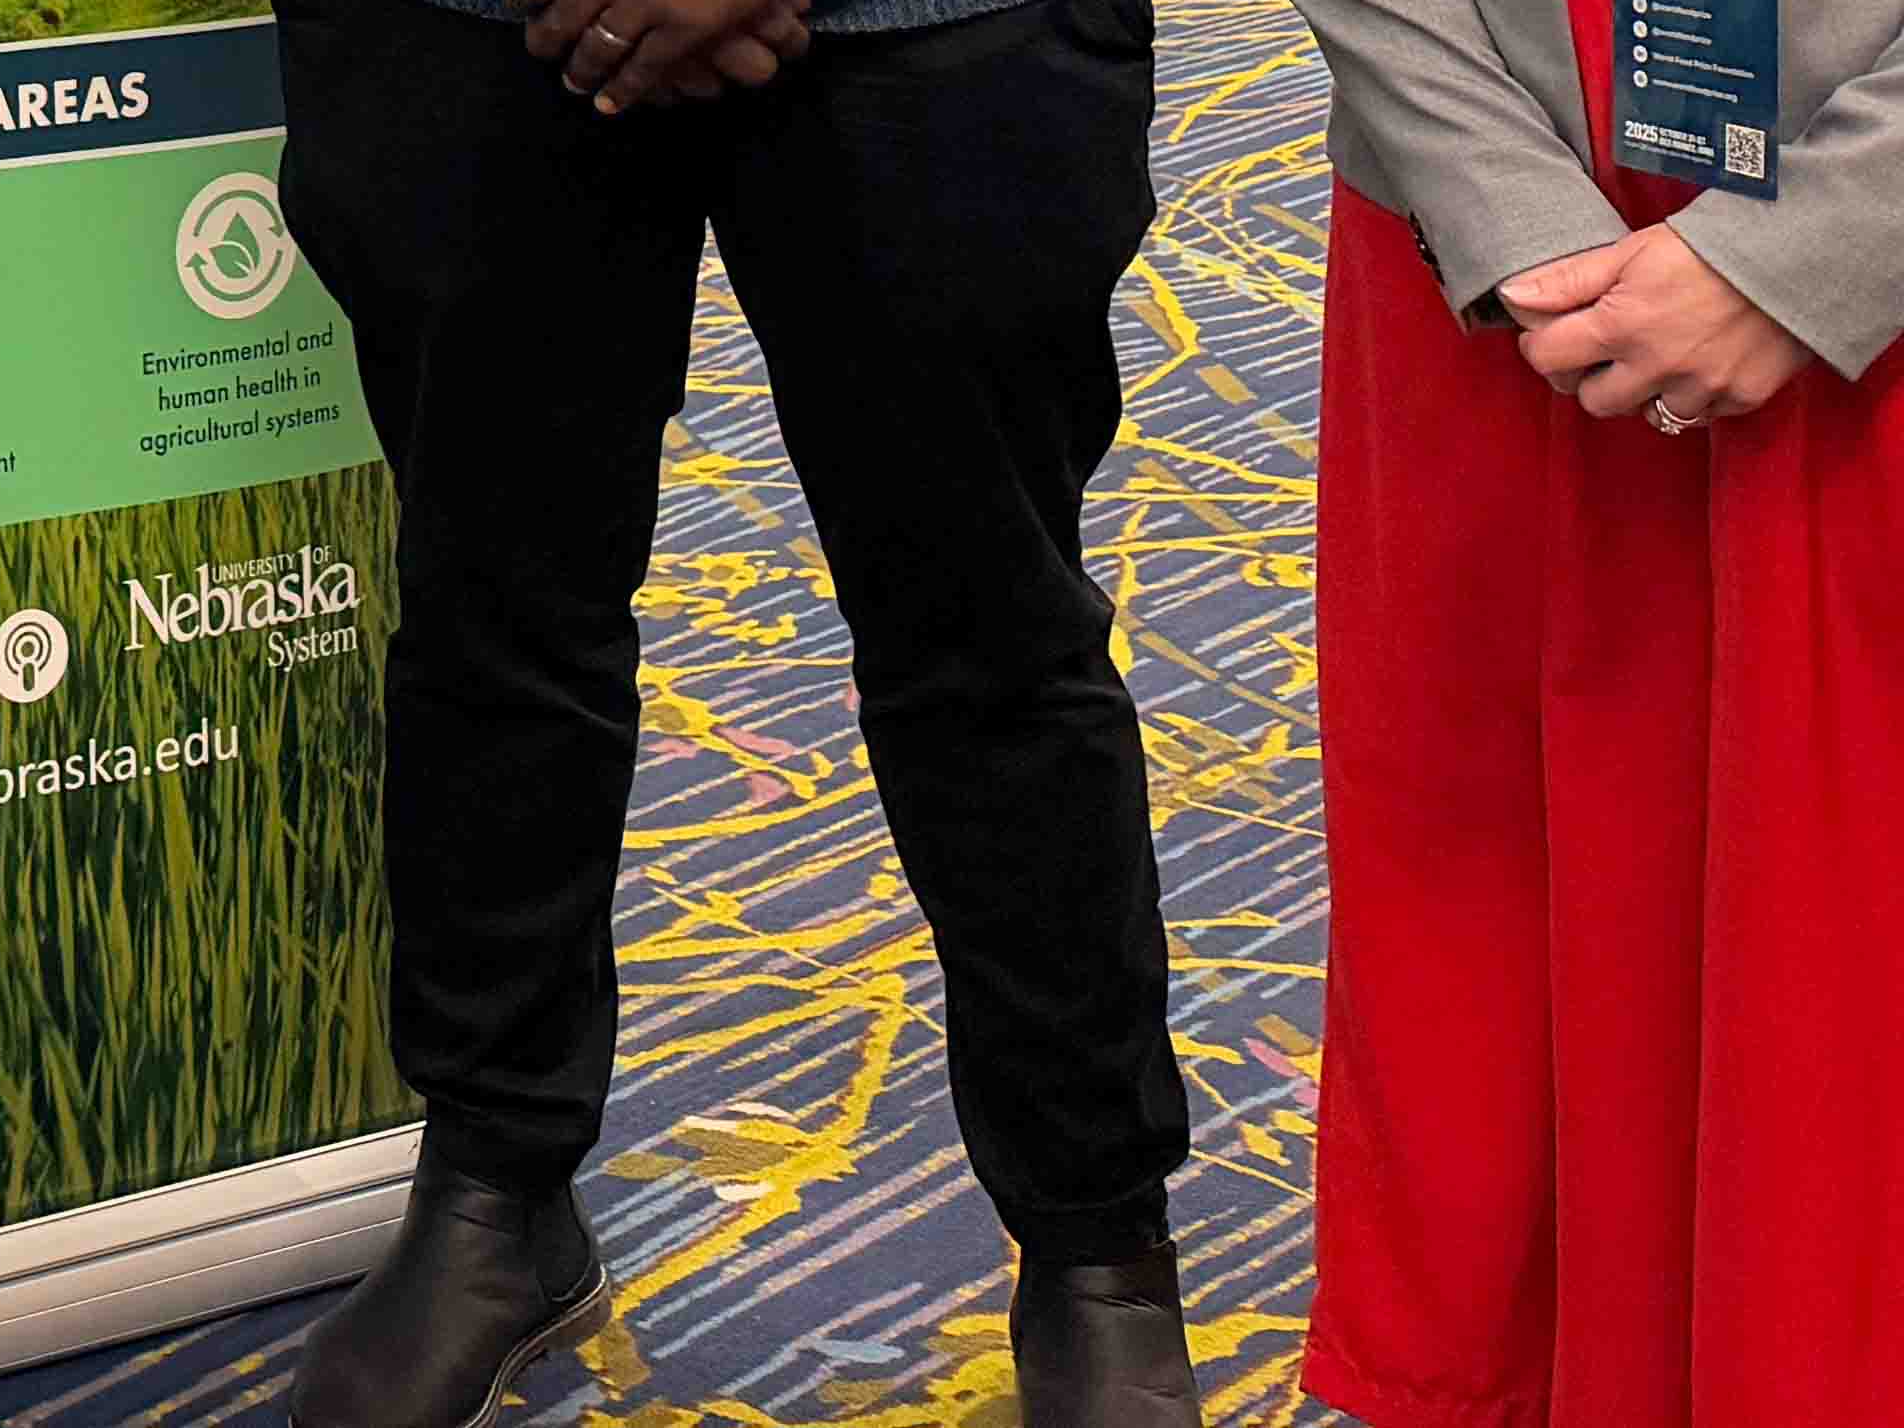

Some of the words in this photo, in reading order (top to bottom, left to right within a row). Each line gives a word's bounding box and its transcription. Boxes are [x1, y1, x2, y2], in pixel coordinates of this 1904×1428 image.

[1625, 120, 1658, 143] 2025
[141, 329, 291, 377] Environmental
[297, 325, 333, 352] and
[157, 381, 230, 412] human
[233, 367, 296, 404] health
[302, 365, 322, 389] in
[140, 415, 260, 456] agricultural
[264, 402, 341, 441] systems
[212, 553, 295, 583] UNIVERSITY
[312, 546, 333, 565] OF
[123, 546, 360, 653] Nebraska
[267, 622, 358, 674] System
